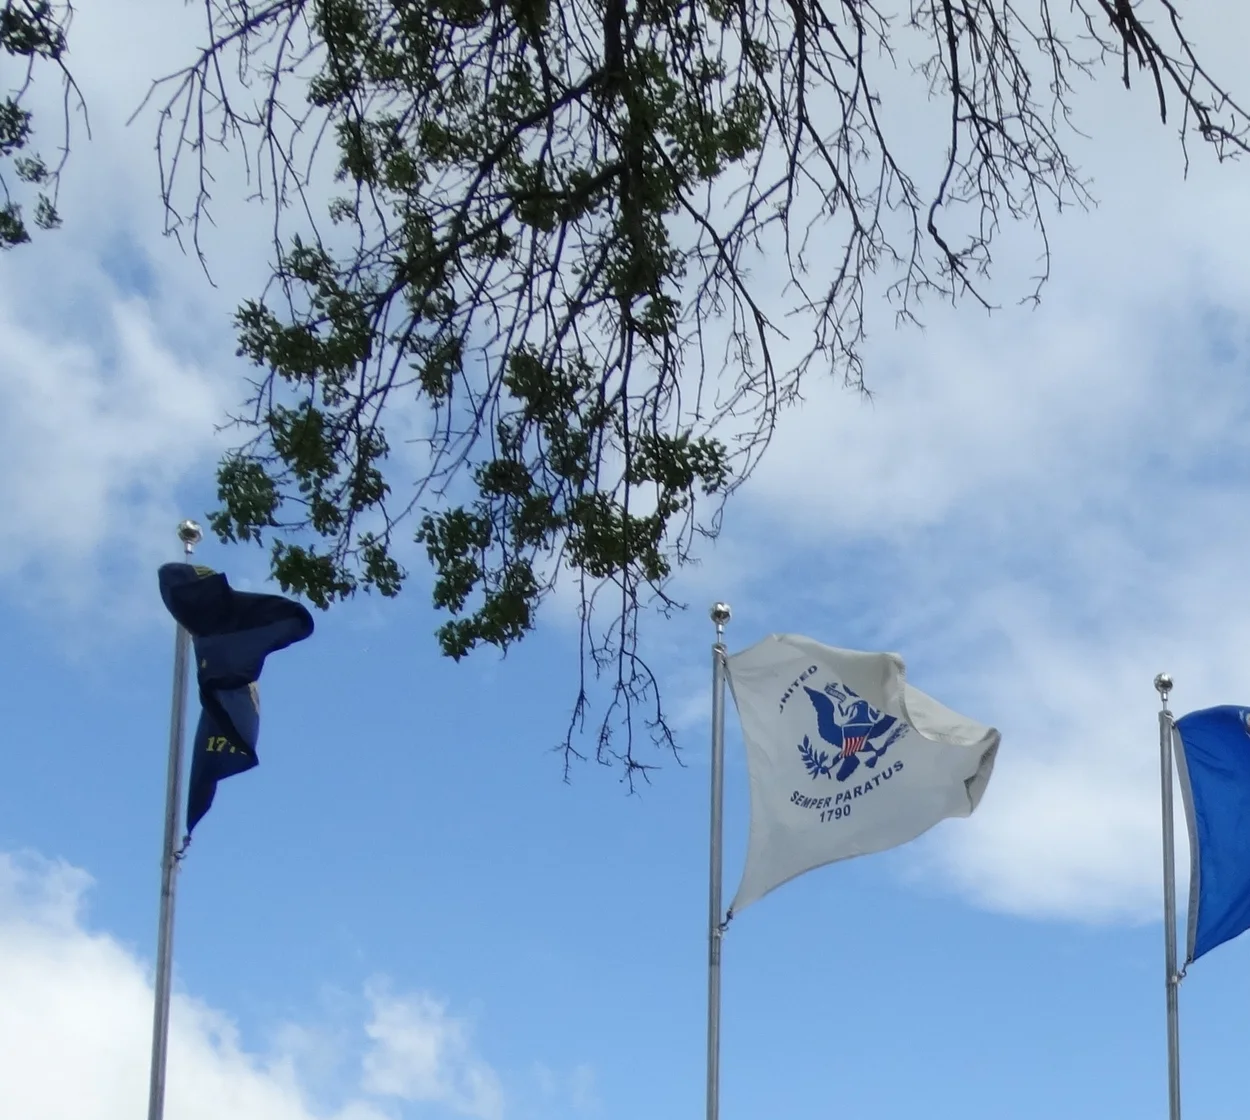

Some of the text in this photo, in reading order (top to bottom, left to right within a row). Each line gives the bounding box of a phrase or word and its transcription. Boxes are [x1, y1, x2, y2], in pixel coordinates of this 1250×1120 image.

[790, 760, 904, 810] SEMPER PARATUS
[819, 804, 852, 823] 1790
